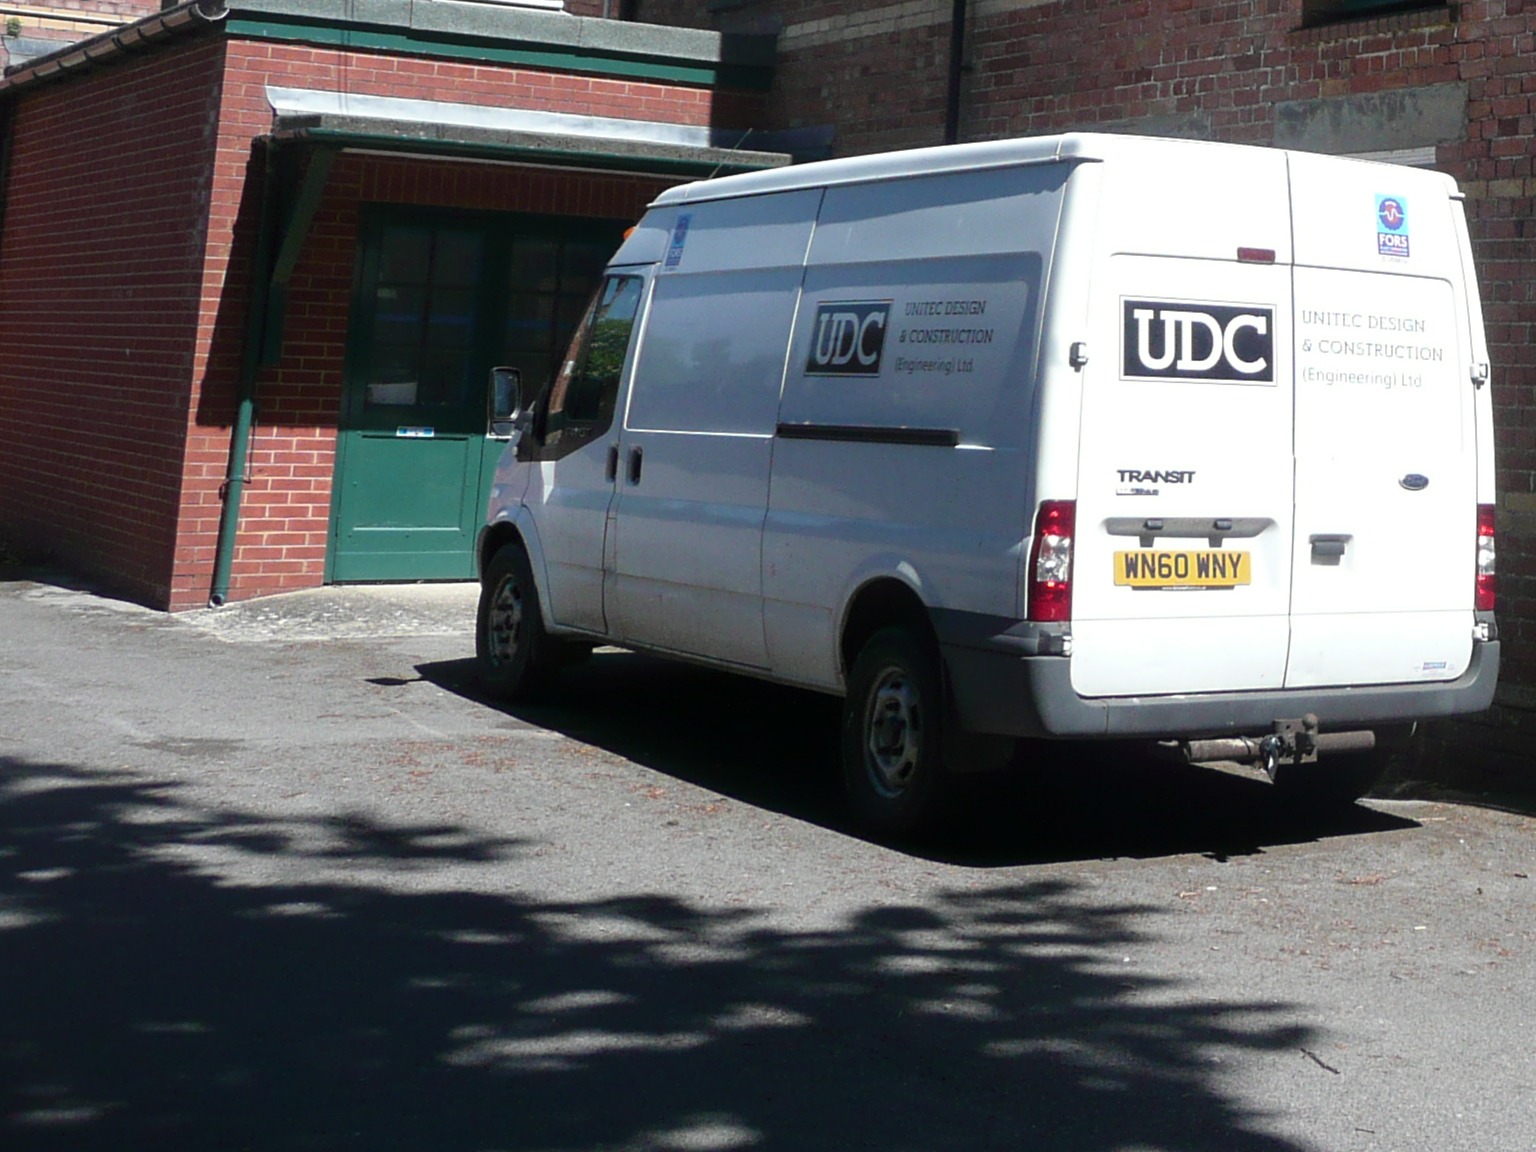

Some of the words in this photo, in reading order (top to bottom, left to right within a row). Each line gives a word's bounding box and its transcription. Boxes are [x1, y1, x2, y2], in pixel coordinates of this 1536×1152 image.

[1379, 233, 1408, 248] FORS
[905, 301, 943, 316] UNITEC
[944, 300, 986, 316] DESIGN
[1302, 310, 1362, 328] UNITEC
[1368, 315, 1425, 332] DESIGN
[815, 311, 886, 365] UDC
[899, 330, 907, 343] &
[909, 329, 994, 343] CONSTRUCTION
[1134, 309, 1267, 374] UDC
[1302, 339, 1312, 352] &
[1318, 340, 1443, 361] CONSTRUCTION
[895, 356, 955, 376] (Engineering)
[1302, 366, 1397, 389] (Engineering)
[1116, 469, 1196, 483] TRANSIT
[1124, 553, 1189, 579] WN60
[1196, 553, 1242, 579] WNY
